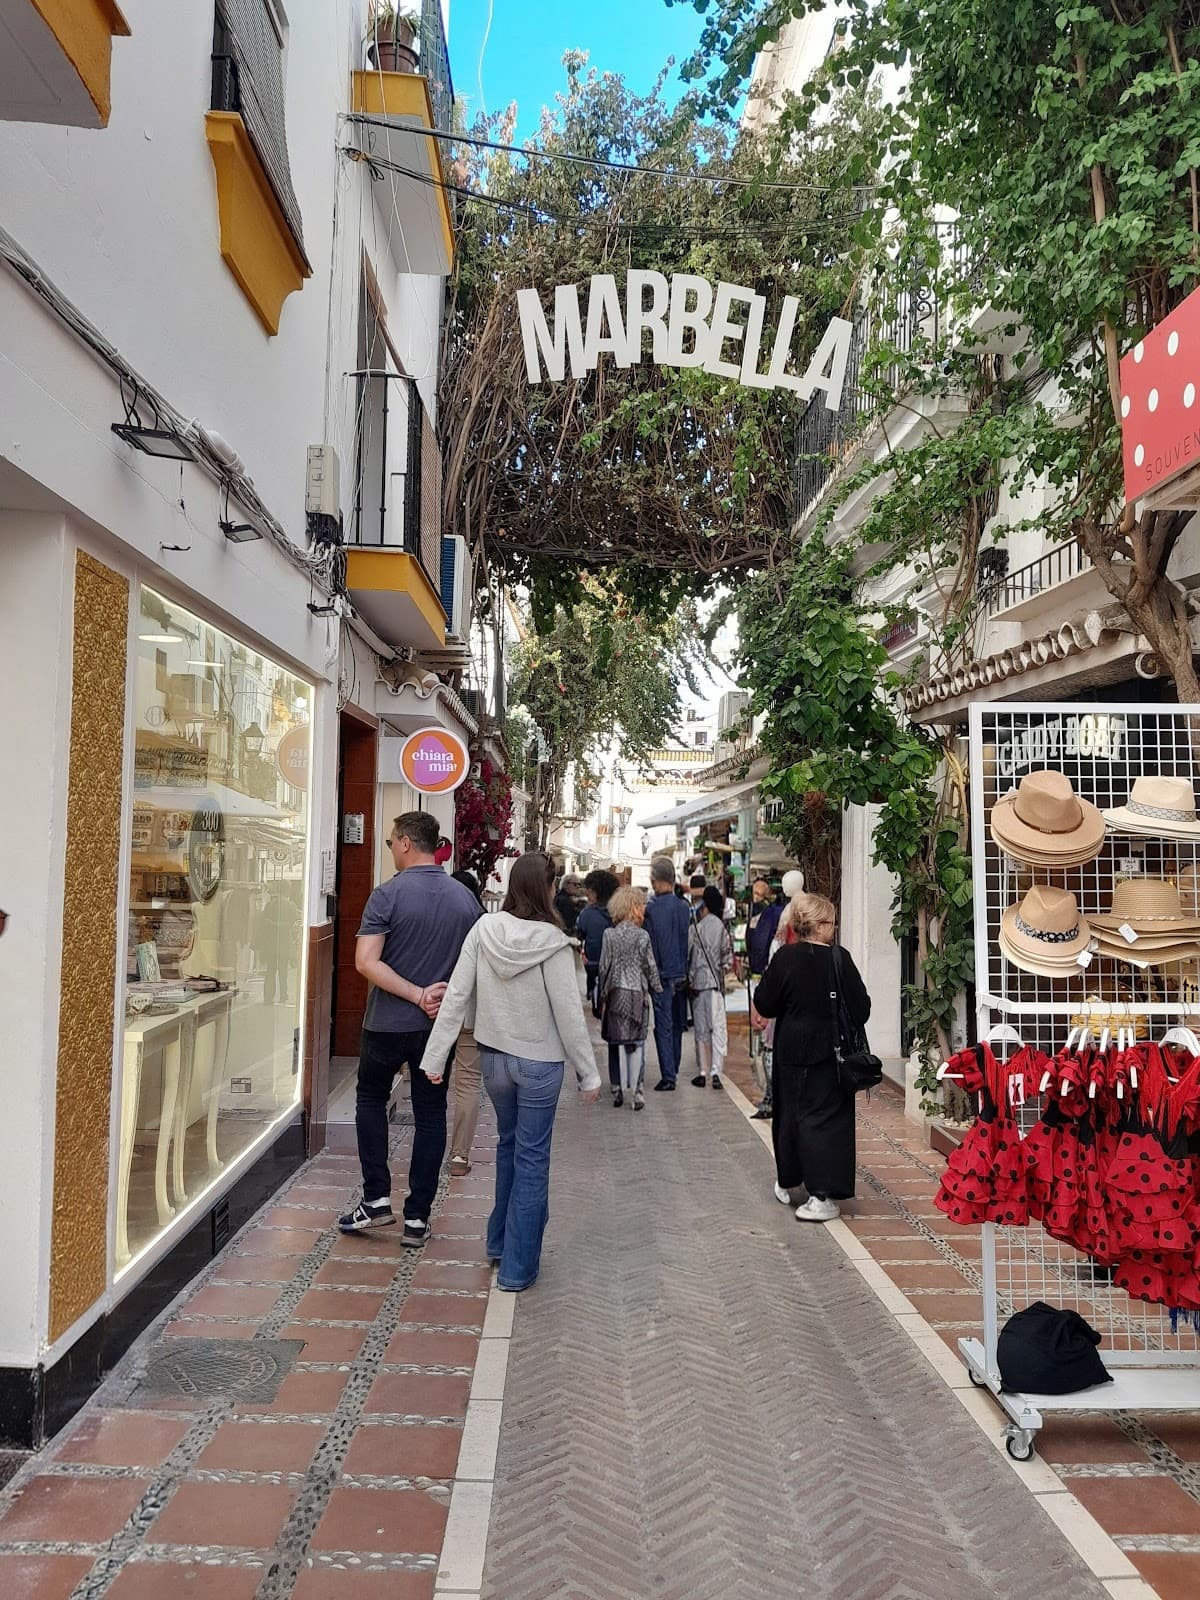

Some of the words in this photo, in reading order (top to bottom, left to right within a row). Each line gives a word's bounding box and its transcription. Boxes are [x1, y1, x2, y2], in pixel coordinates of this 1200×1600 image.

[517, 269, 853, 411] MARBELLA
[411, 748, 454, 761] chiara
[1000, 719, 1061, 776] CANDY
[1065, 715, 1126, 760] BOAT
[202, 809, 219, 831] 300
